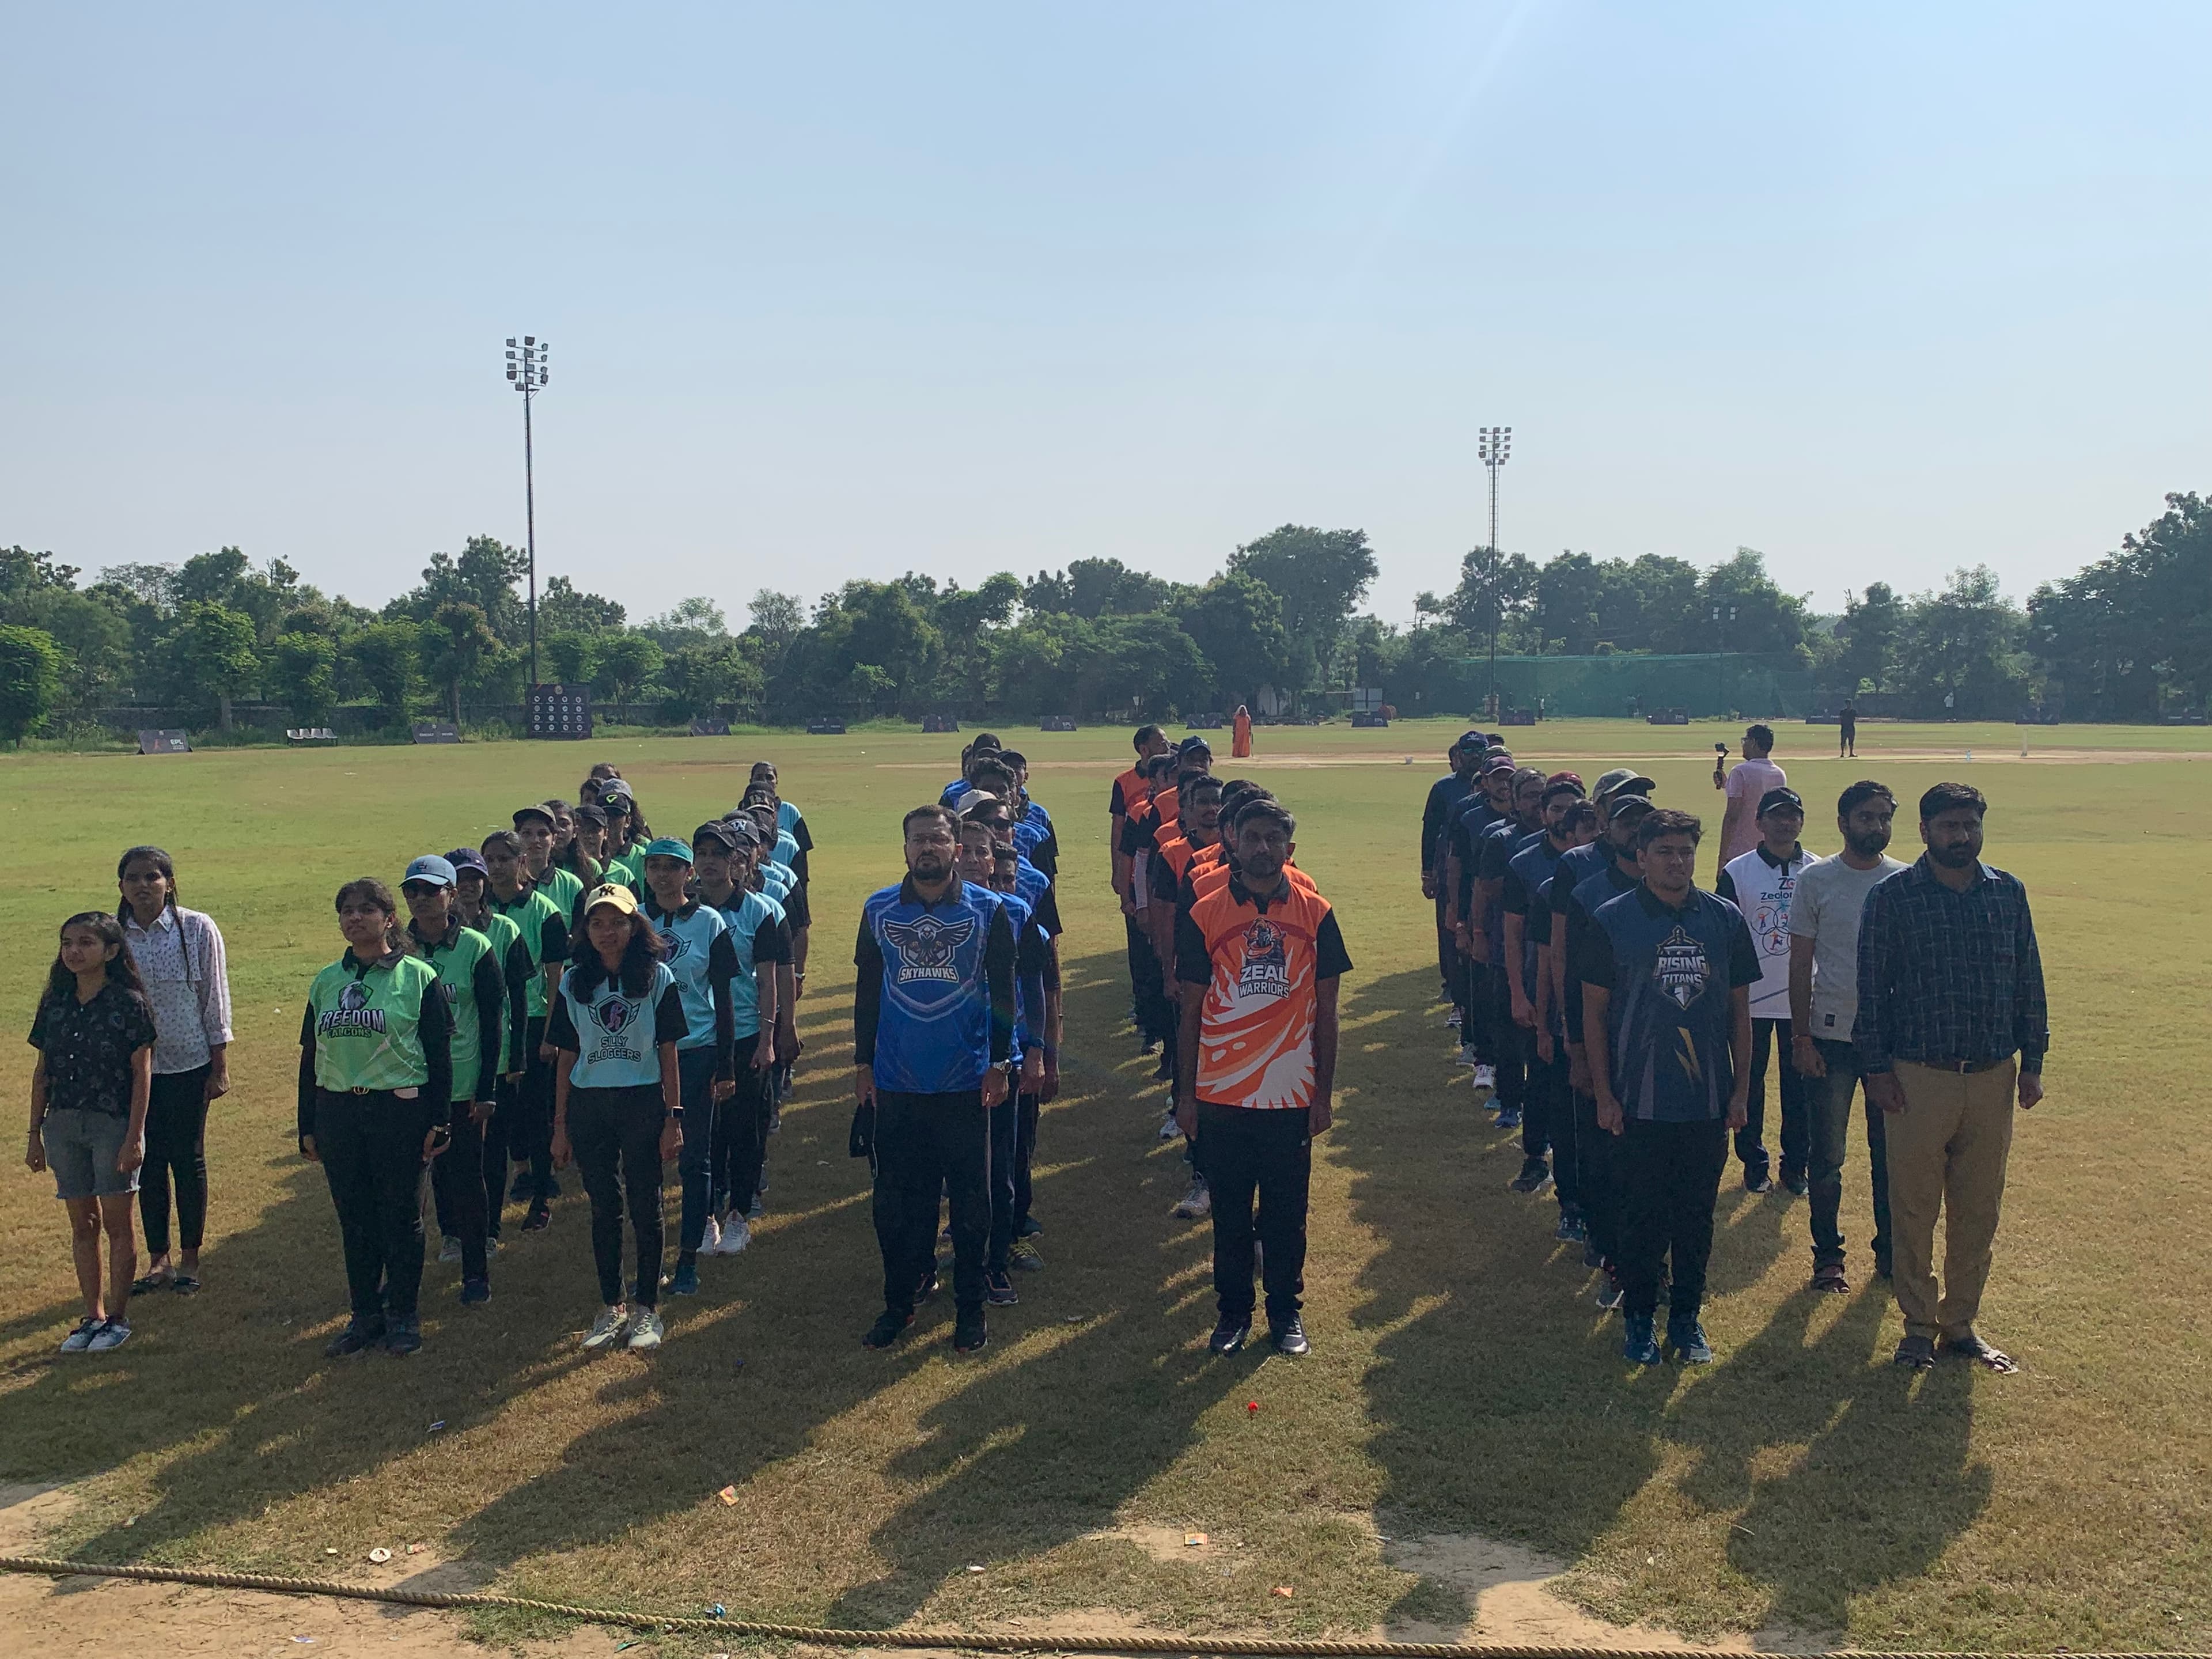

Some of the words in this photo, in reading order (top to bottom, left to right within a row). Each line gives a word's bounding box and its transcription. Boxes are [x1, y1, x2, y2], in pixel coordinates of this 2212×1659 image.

[899, 967, 957, 982] SKYHAWKS
[1240, 964, 1290, 984] ZEAL
[1657, 955, 1708, 976] RISING
[1238, 981, 1291, 999] WARRIORS
[1661, 974, 1703, 988] TITANS
[317, 1009, 387, 1036] FREEDOM
[327, 1027, 372, 1039] FALCONS
[600, 1035, 629, 1048] SILLY
[587, 1047, 641, 1065] SLOGGERS
